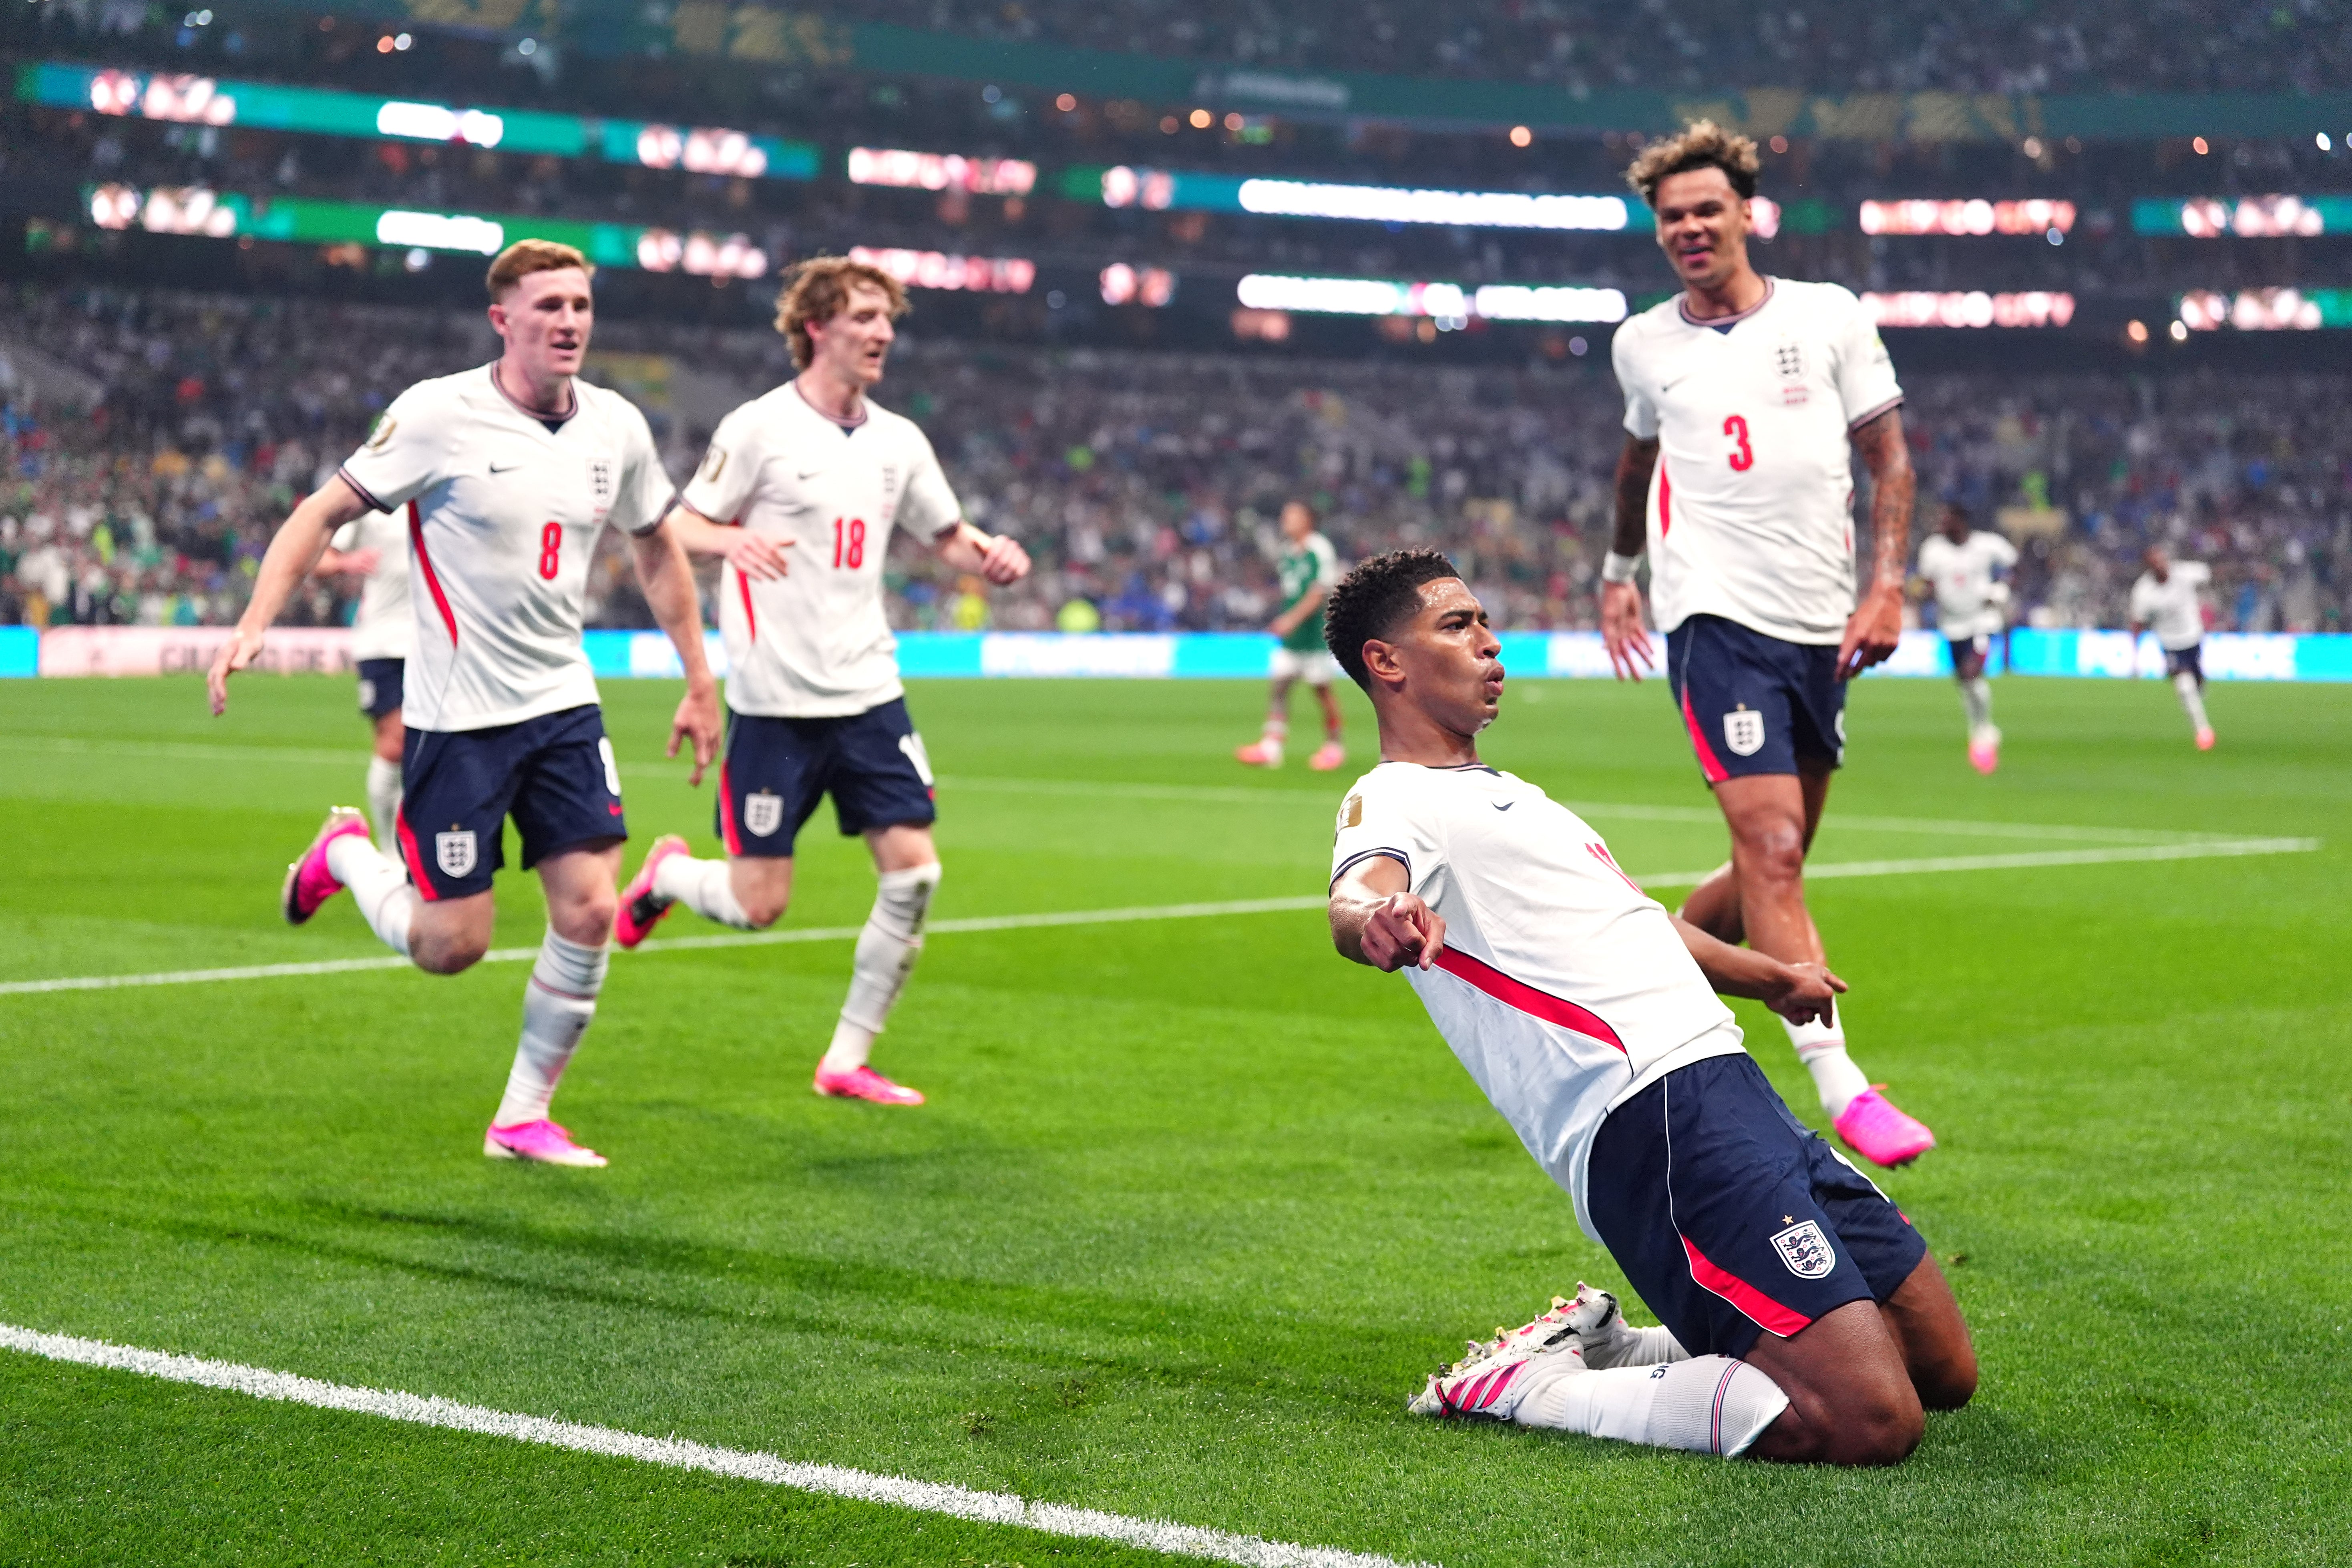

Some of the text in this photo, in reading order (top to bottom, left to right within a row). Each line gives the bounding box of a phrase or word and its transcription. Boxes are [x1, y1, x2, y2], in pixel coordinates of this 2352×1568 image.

[1724, 416, 1753, 471] 3
[540, 523, 562, 579] 8
[834, 518, 865, 569] 18
